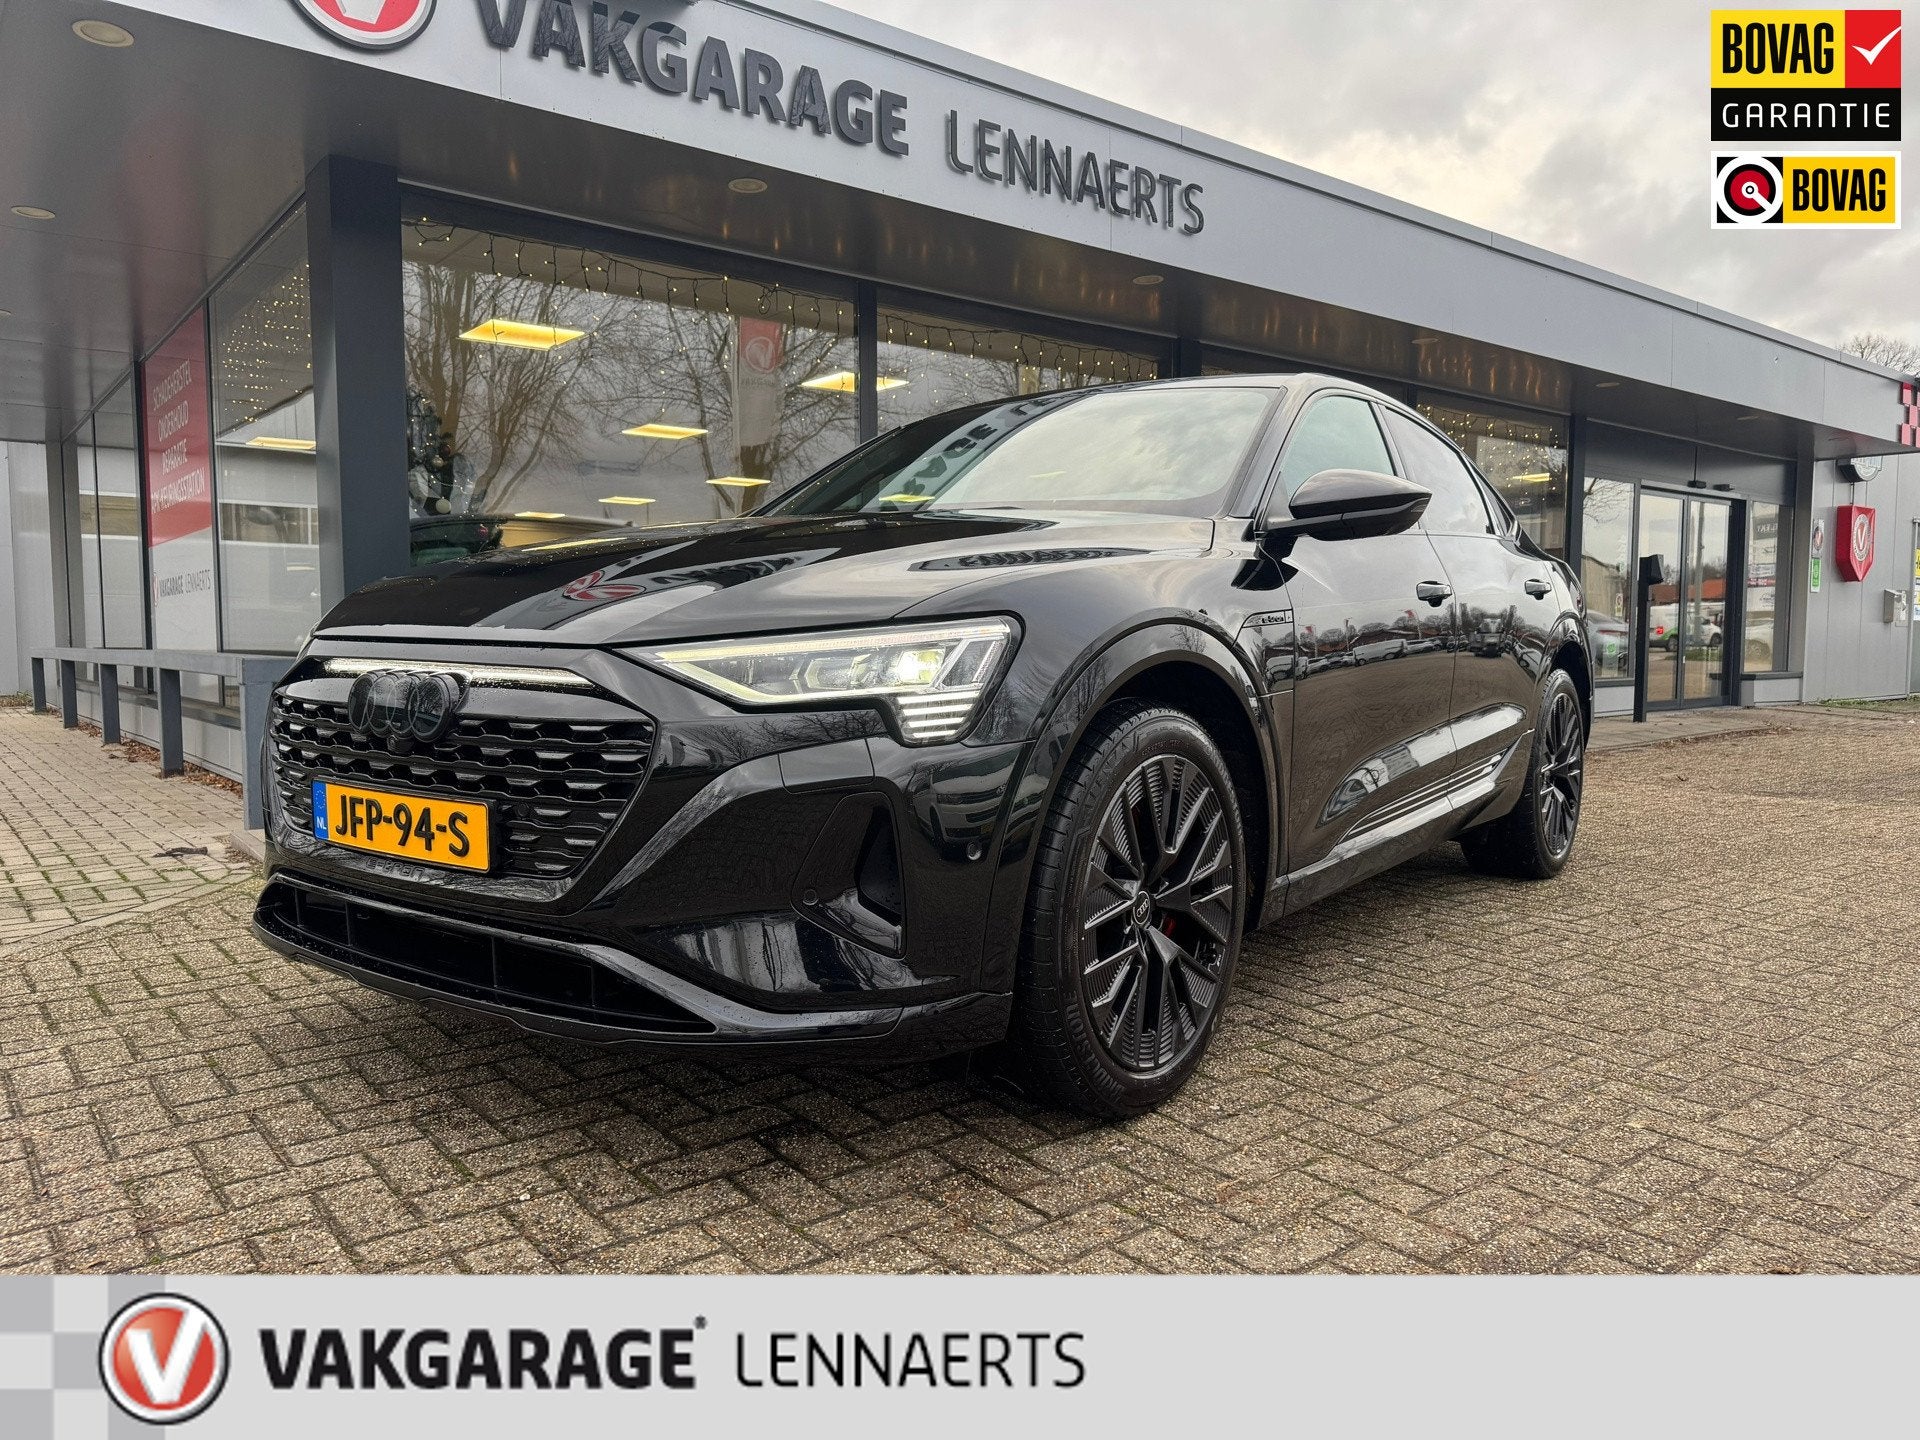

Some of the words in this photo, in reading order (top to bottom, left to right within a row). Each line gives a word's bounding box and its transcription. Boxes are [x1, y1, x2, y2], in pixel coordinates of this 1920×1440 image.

[477, 0, 909, 156] VAKGARAGE
[948, 109, 1206, 236] LENNAERTS
[316, 816, 327, 830] NL
[335, 793, 470, 858] JFP-94-S
